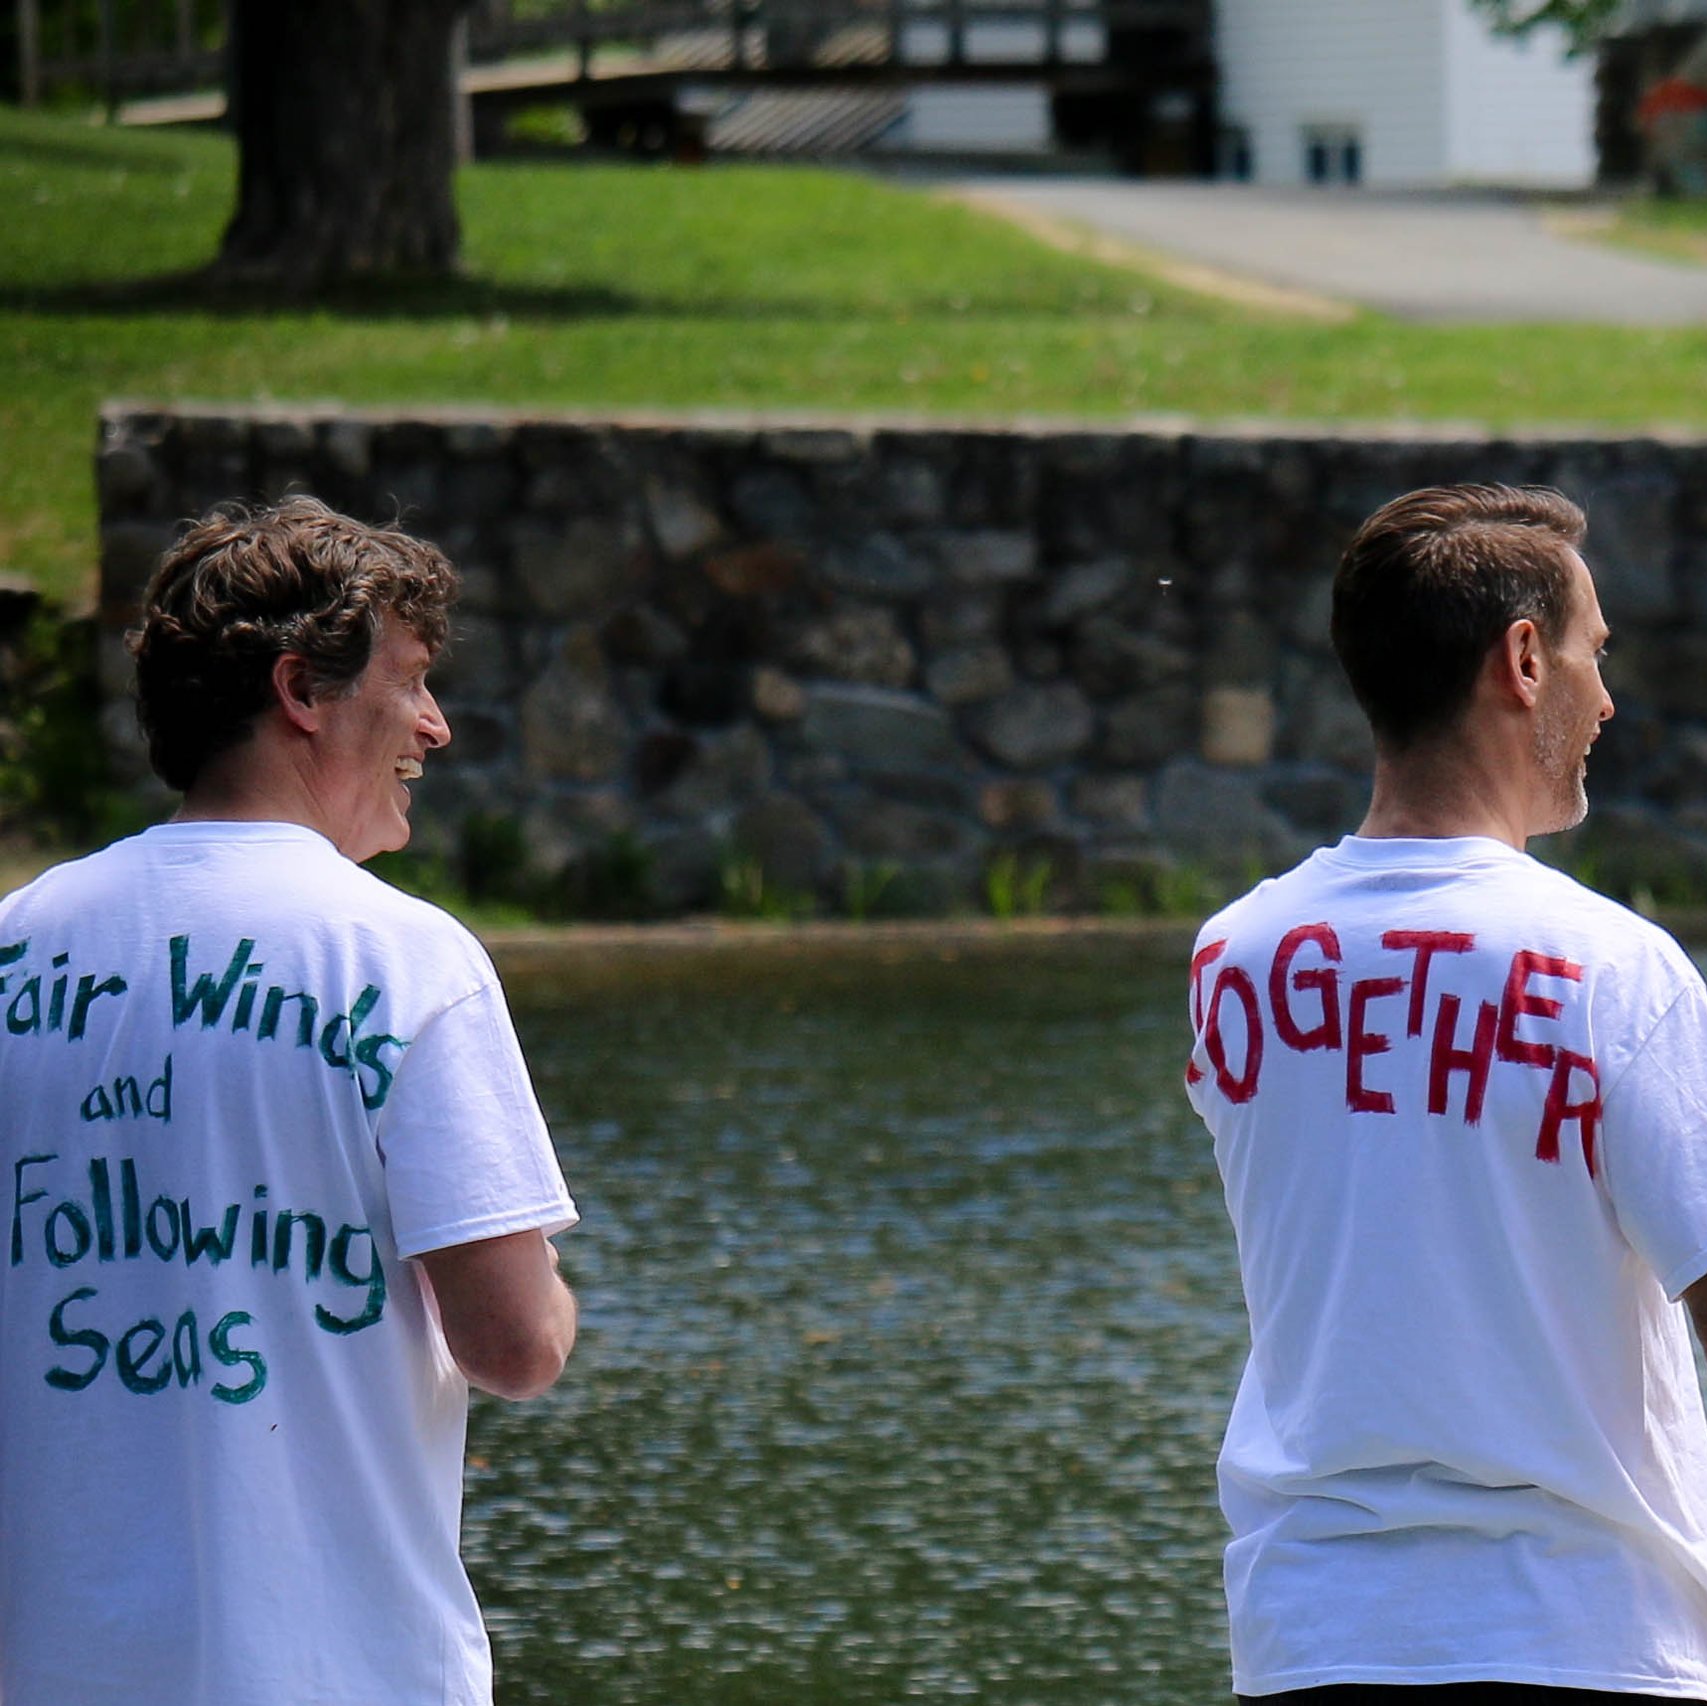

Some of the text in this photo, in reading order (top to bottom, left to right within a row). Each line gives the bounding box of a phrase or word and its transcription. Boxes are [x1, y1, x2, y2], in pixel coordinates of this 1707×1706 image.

[80, 1054, 174, 1124] and
[167, 934, 412, 1112] Winds
[1184, 921, 1602, 1181] TOGETHER
[9, 1152, 387, 1336] Following
[43, 1287, 268, 1405] Seas
